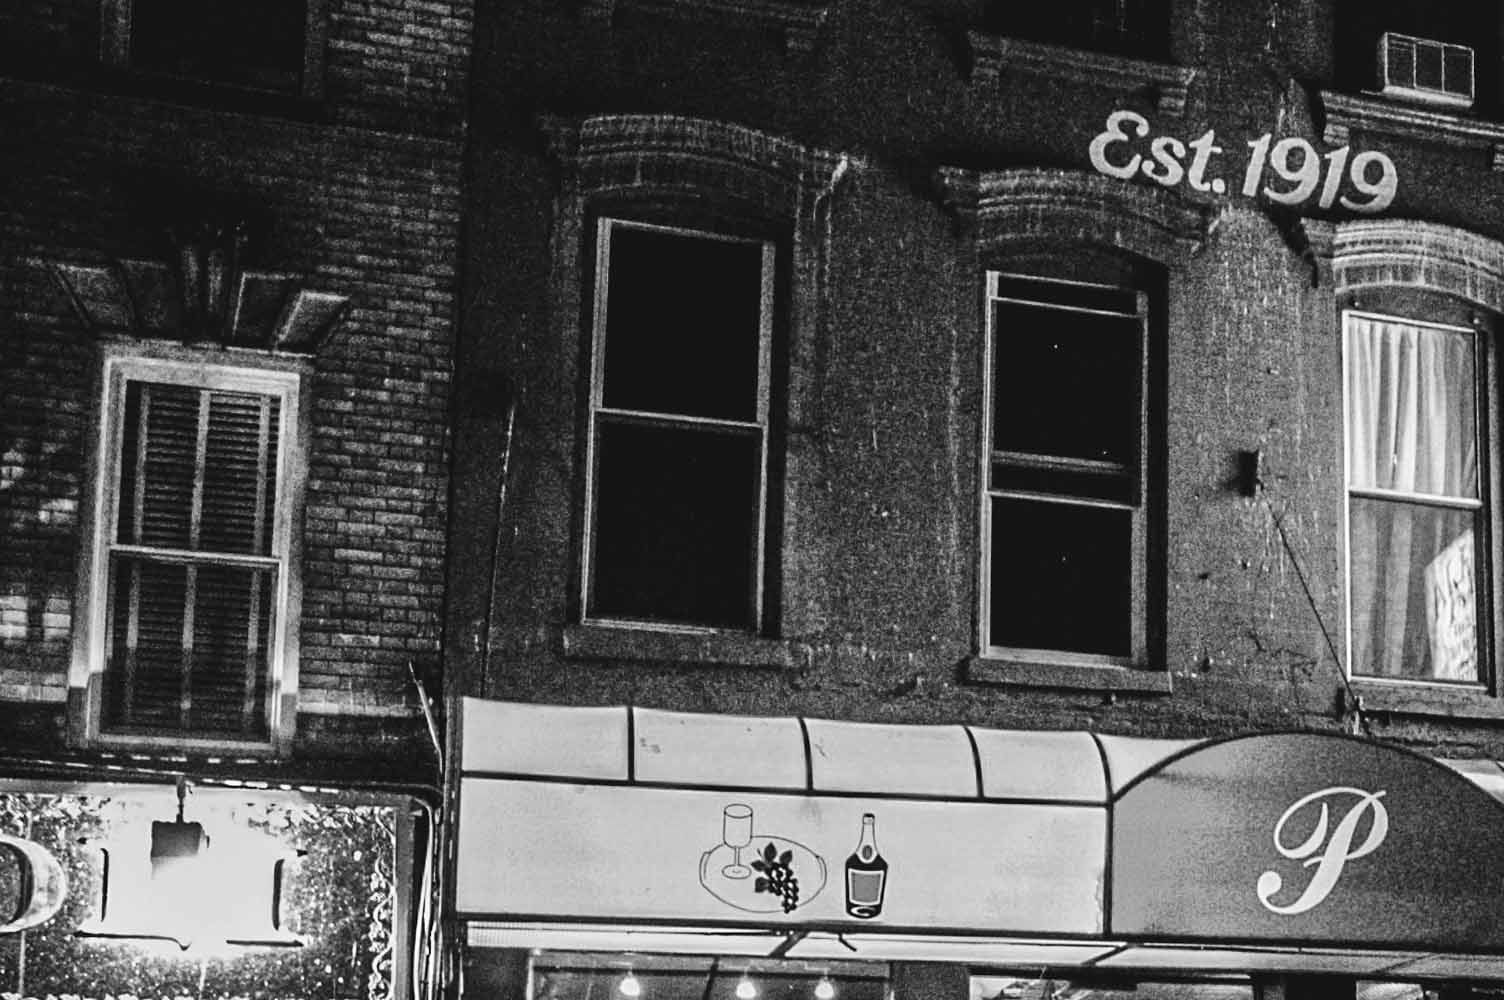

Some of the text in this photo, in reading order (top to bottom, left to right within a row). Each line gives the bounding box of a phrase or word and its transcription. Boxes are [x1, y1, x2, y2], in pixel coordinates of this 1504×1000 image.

[1088, 110, 1399, 212] Est. 1919
[1256, 786, 1389, 915] P
